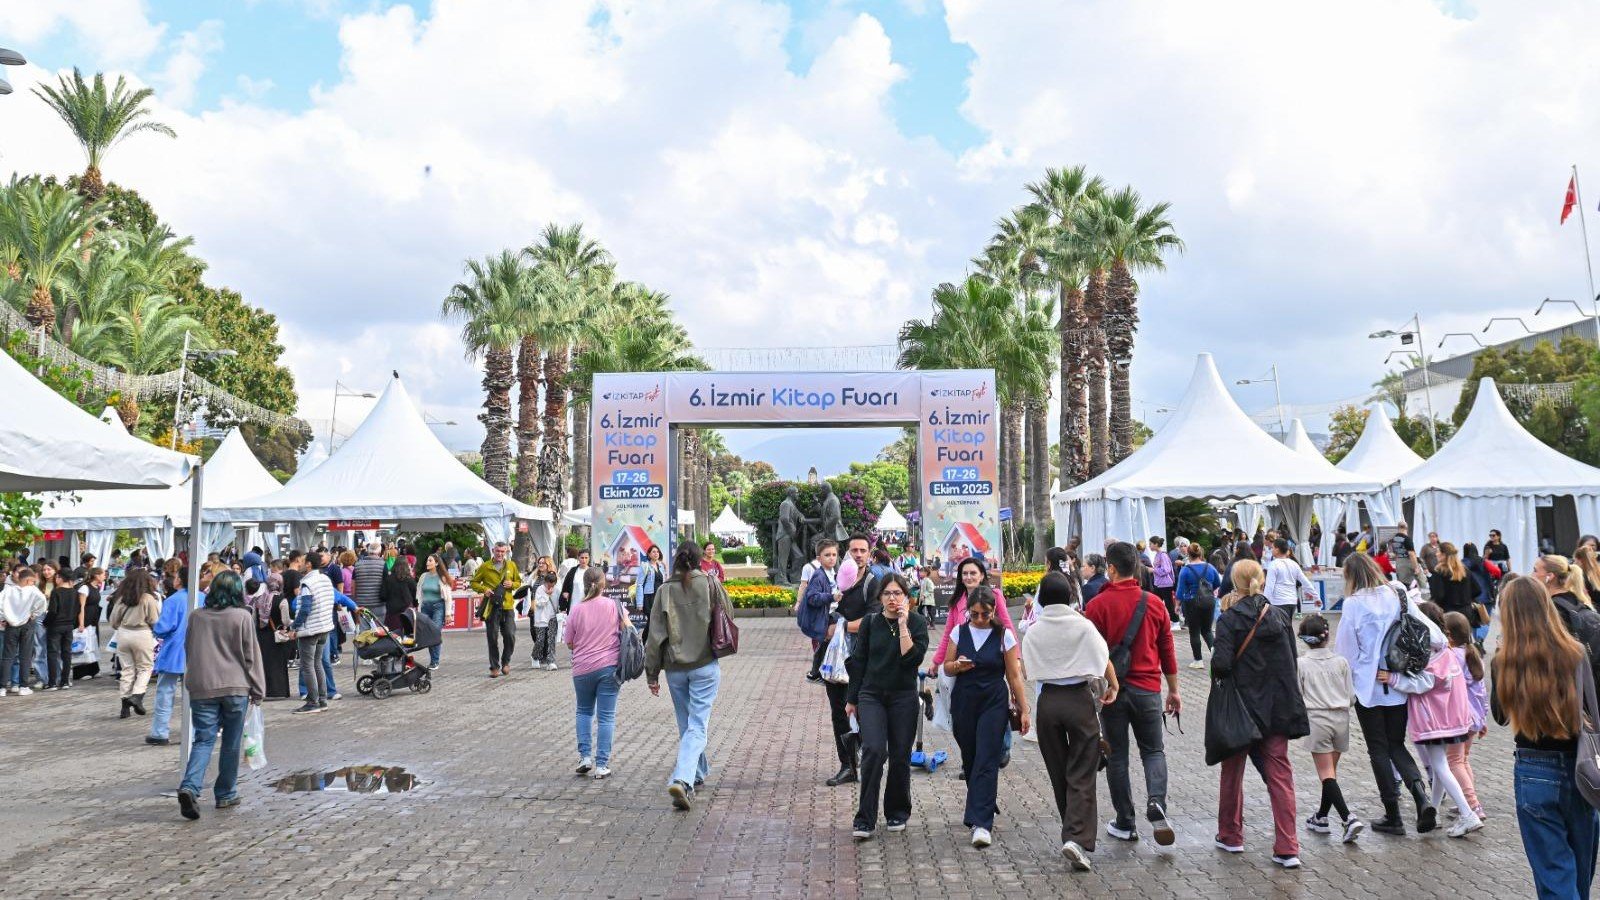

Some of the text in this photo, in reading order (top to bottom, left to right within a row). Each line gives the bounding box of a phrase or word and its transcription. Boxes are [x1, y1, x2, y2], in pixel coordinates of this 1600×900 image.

[689, 383, 898, 411] 6. İzmir Kitap Fuarı
[600, 409, 663, 429] 6. İzmir
[928, 406, 991, 426] 6. İzmir
[605, 432, 657, 448] Kitap
[934, 429, 986, 446] Kitap
[608, 450, 655, 465] Fuarı
[938, 447, 983, 462] Fuarı
[616, 472, 647, 484] 17-26
[945, 469, 977, 481] 17-26
[603, 486, 660, 498] Ekim 2025
[933, 483, 990, 495] Ekim 2025
